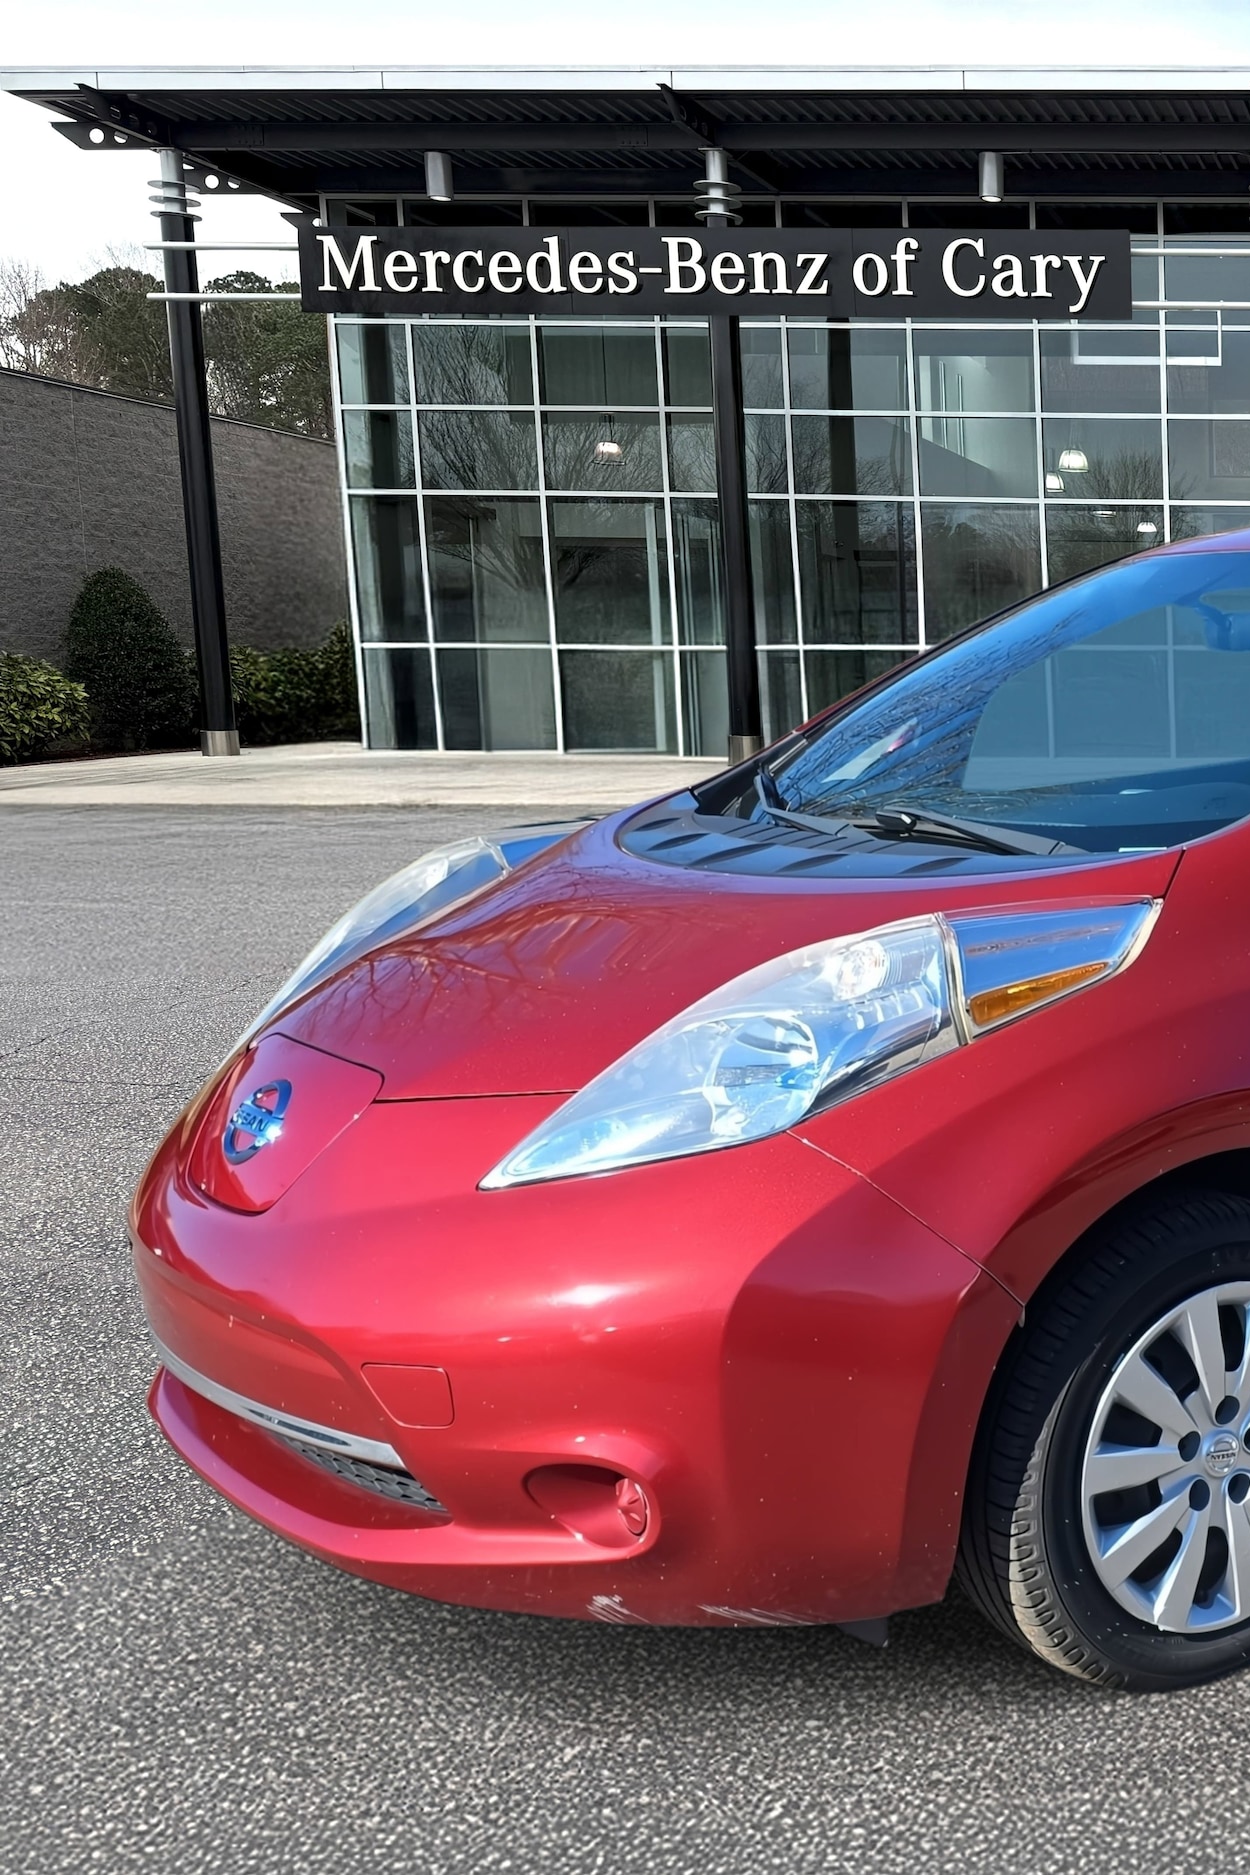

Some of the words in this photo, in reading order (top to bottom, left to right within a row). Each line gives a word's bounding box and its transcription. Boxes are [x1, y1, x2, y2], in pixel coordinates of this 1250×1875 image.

[315, 235, 829, 295] Mercedes-Benz
[852, 237, 919, 296] of
[942, 238, 1106, 313] Cary
